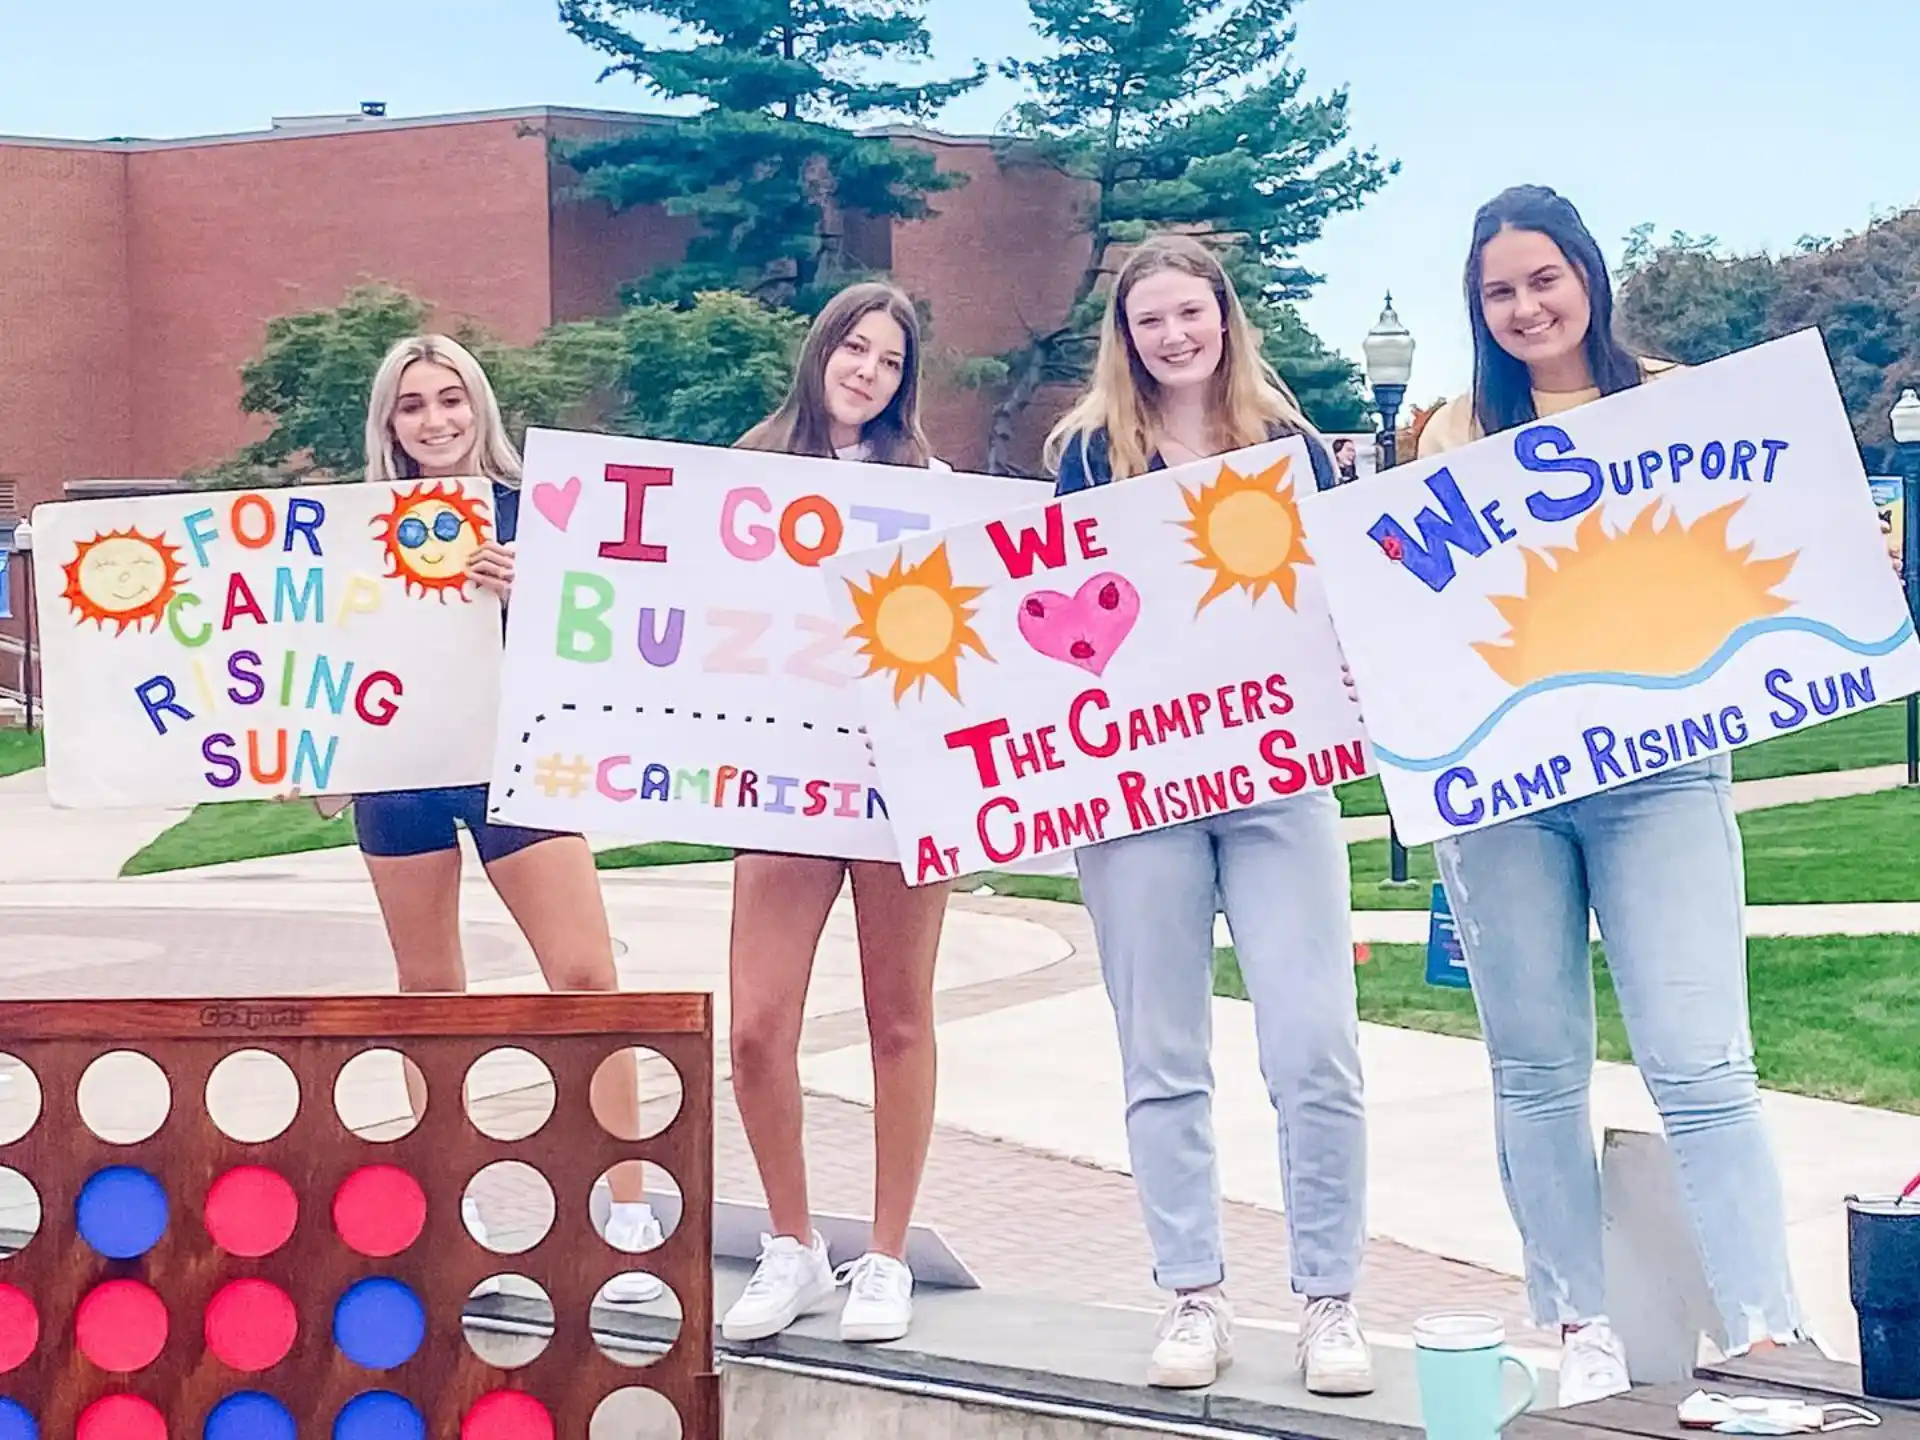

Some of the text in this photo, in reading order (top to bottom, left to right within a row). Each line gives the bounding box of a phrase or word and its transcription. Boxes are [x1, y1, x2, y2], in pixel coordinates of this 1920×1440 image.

[184, 494, 325, 567] FOR
[598, 464, 930, 567] I GOT
[985, 503, 1108, 579] WE
[1367, 425, 1788, 592] WE SUPPORT
[168, 567, 383, 647] CAMP
[134, 650, 403, 735] RISING
[944, 673, 1295, 788] THE CAMPERS
[202, 729, 339, 789] SUN
[1434, 667, 1876, 826] CAMP RISING SUN
[917, 729, 1366, 883] AT CAMP RISING SUN
